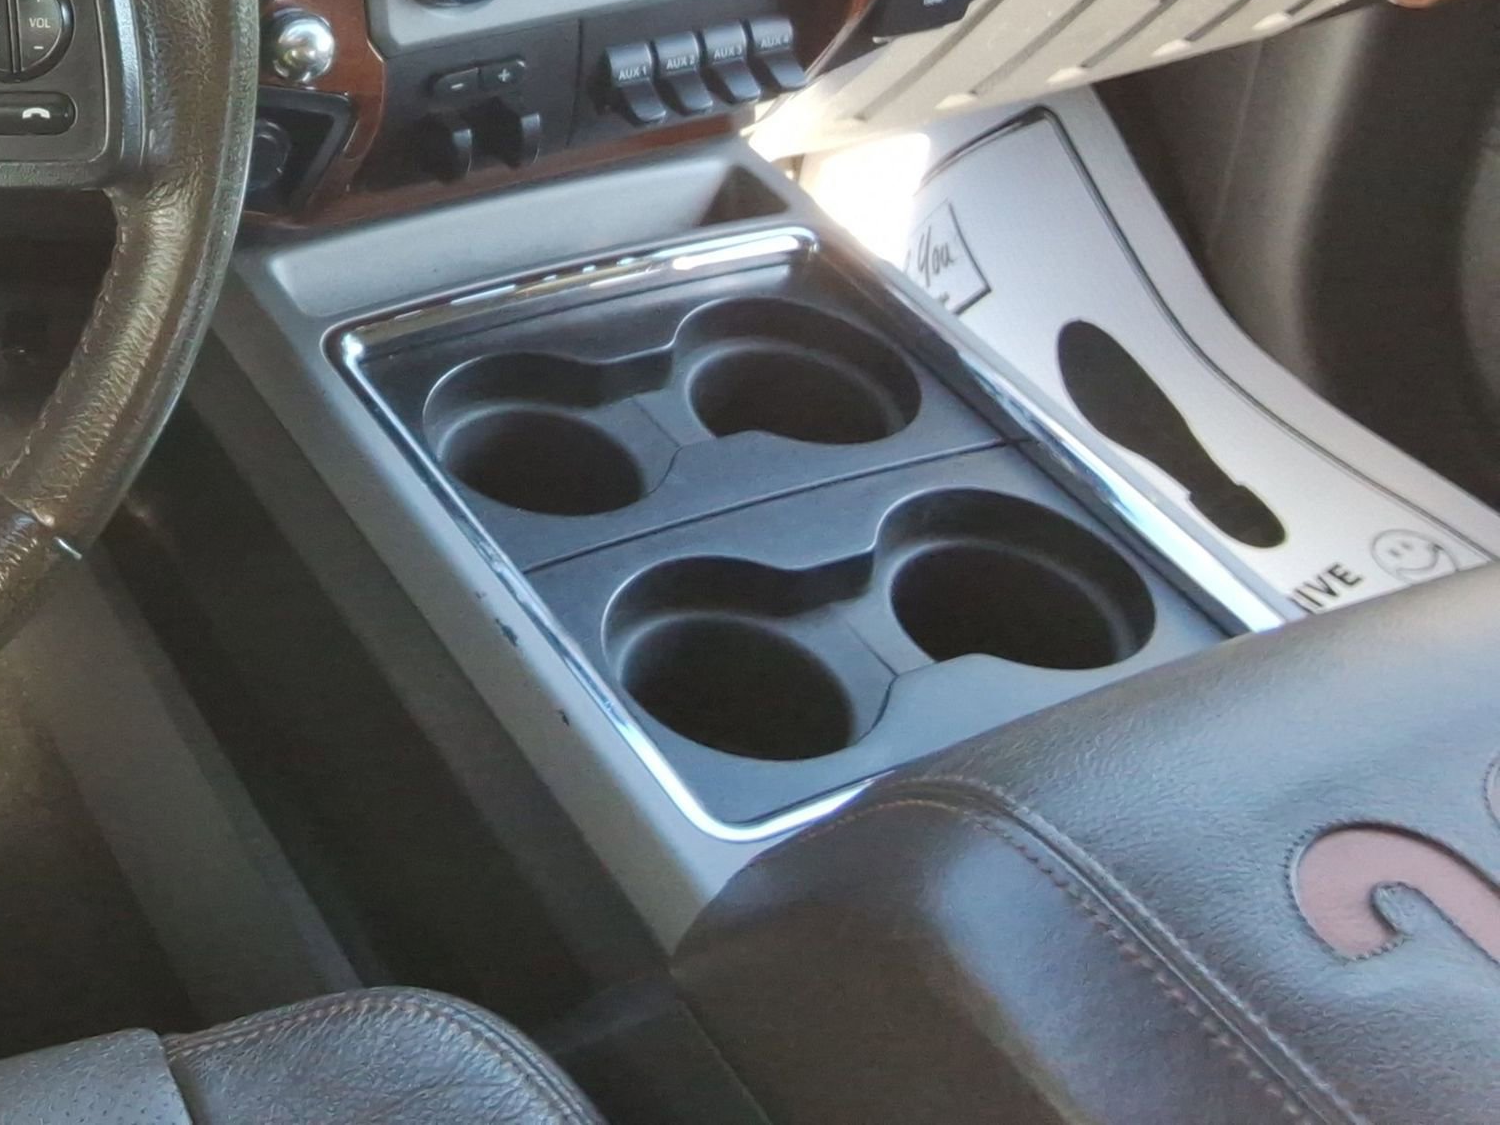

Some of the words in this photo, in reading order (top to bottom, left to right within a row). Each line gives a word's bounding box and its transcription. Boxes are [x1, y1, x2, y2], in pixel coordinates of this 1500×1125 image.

[29, 17, 51, 29] VOL
[760, 35, 780, 49] AUX
[713, 46, 734, 60] AUX
[666, 56, 687, 70] AUX
[687, 55, 696, 67] 2
[618, 66, 639, 80] AUX
[641, 66, 648, 78] 1
